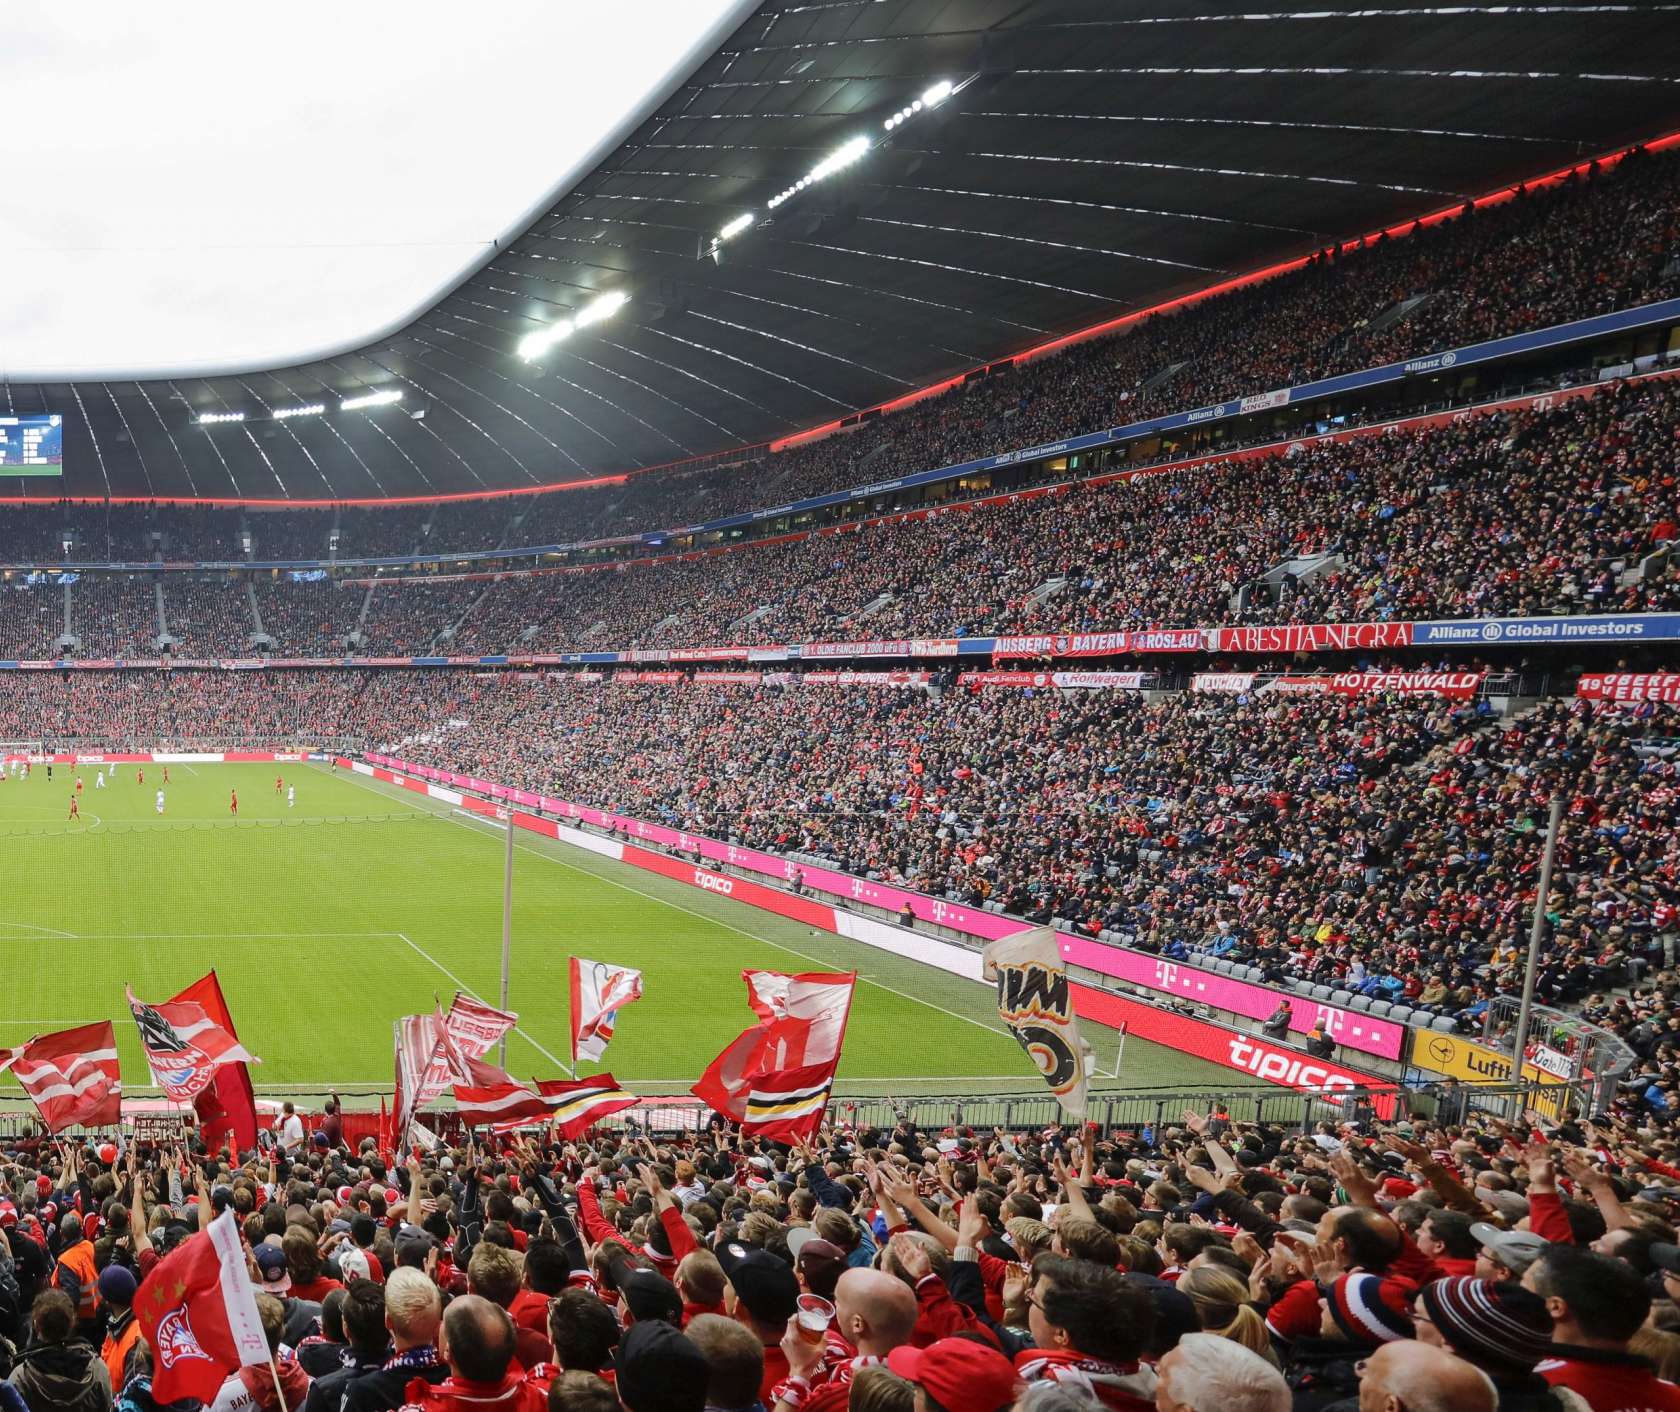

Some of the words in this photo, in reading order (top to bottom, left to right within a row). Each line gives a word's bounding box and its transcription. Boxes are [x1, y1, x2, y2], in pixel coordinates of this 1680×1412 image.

[1405, 358, 1440, 372] Allianz
[1241, 401, 1271, 412] KINGS
[1187, 410, 1213, 421] Allianz
[1246, 625, 1320, 651] BESTIA
[1325, 622, 1408, 650] NEGRA
[1429, 626, 1479, 639] Allianz
[1505, 622, 1557, 637] Global
[1561, 621, 1643, 636] Investors
[817, 644, 835, 655] OLDIE
[836, 643, 865, 655] FANCLUB
[867, 643, 883, 654] 2000
[994, 636, 1053, 653] AUSBERG
[1072, 633, 1126, 650] BAYERN
[855, 672, 889, 684] POWER
[982, 675, 1000, 683] Audi
[1001, 675, 1031, 683] Fanclub
[1333, 673, 1479, 689] HOTZENWALD
[1578, 677, 1601, 691] 19
[1603, 674, 1680, 688] OBERF
[694, 867, 733, 894] tipico
[1228, 1033, 1357, 1101] tipico
